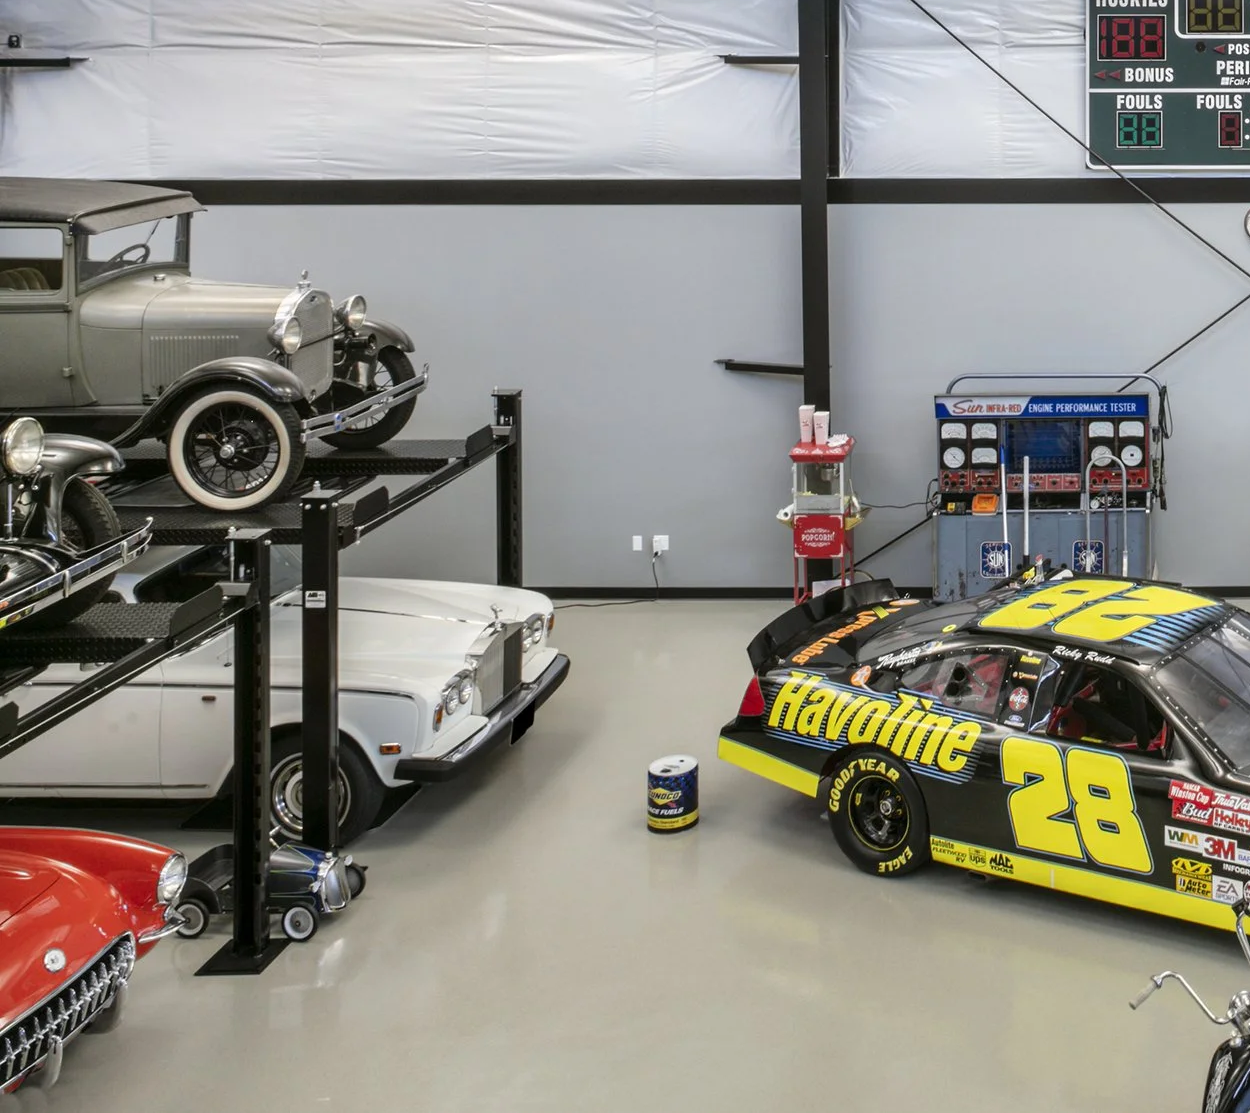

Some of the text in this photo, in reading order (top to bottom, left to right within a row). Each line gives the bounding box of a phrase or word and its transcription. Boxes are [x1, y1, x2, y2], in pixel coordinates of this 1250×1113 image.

[1124, 67, 1174, 82] BONUS
[1116, 94, 1163, 109] FOULS
[1196, 94, 1243, 109] FOULS
[952, 399, 1137, 415] Sun INFRA-RED ENGINE PERFORMANCE TESTER
[989, 552, 1004, 567] SUN
[1081, 552, 1096, 566] SN
[1052, 645, 1117, 665] Ricky Rudd
[767, 670, 983, 775] Havoline
[828, 758, 900, 813] GOODYEAR
[1170, 786, 1210, 805] Winston Cup
[660, 806, 685, 817] FUELS
[1001, 734, 1155, 877] 28
[1182, 802, 1213, 820] Bud
[1167, 828, 1200, 846] WM
[1203, 836, 1236, 862] 3M
[878, 845, 914, 873] EAGLE
[969, 855, 986, 865] ups
[989, 853, 1014, 870] MAC
[990, 865, 1014, 875] TOOLS
[1184, 885, 1211, 897] Meter
[1187, 879, 1207, 890] Auto
[1216, 880, 1239, 897] EA
